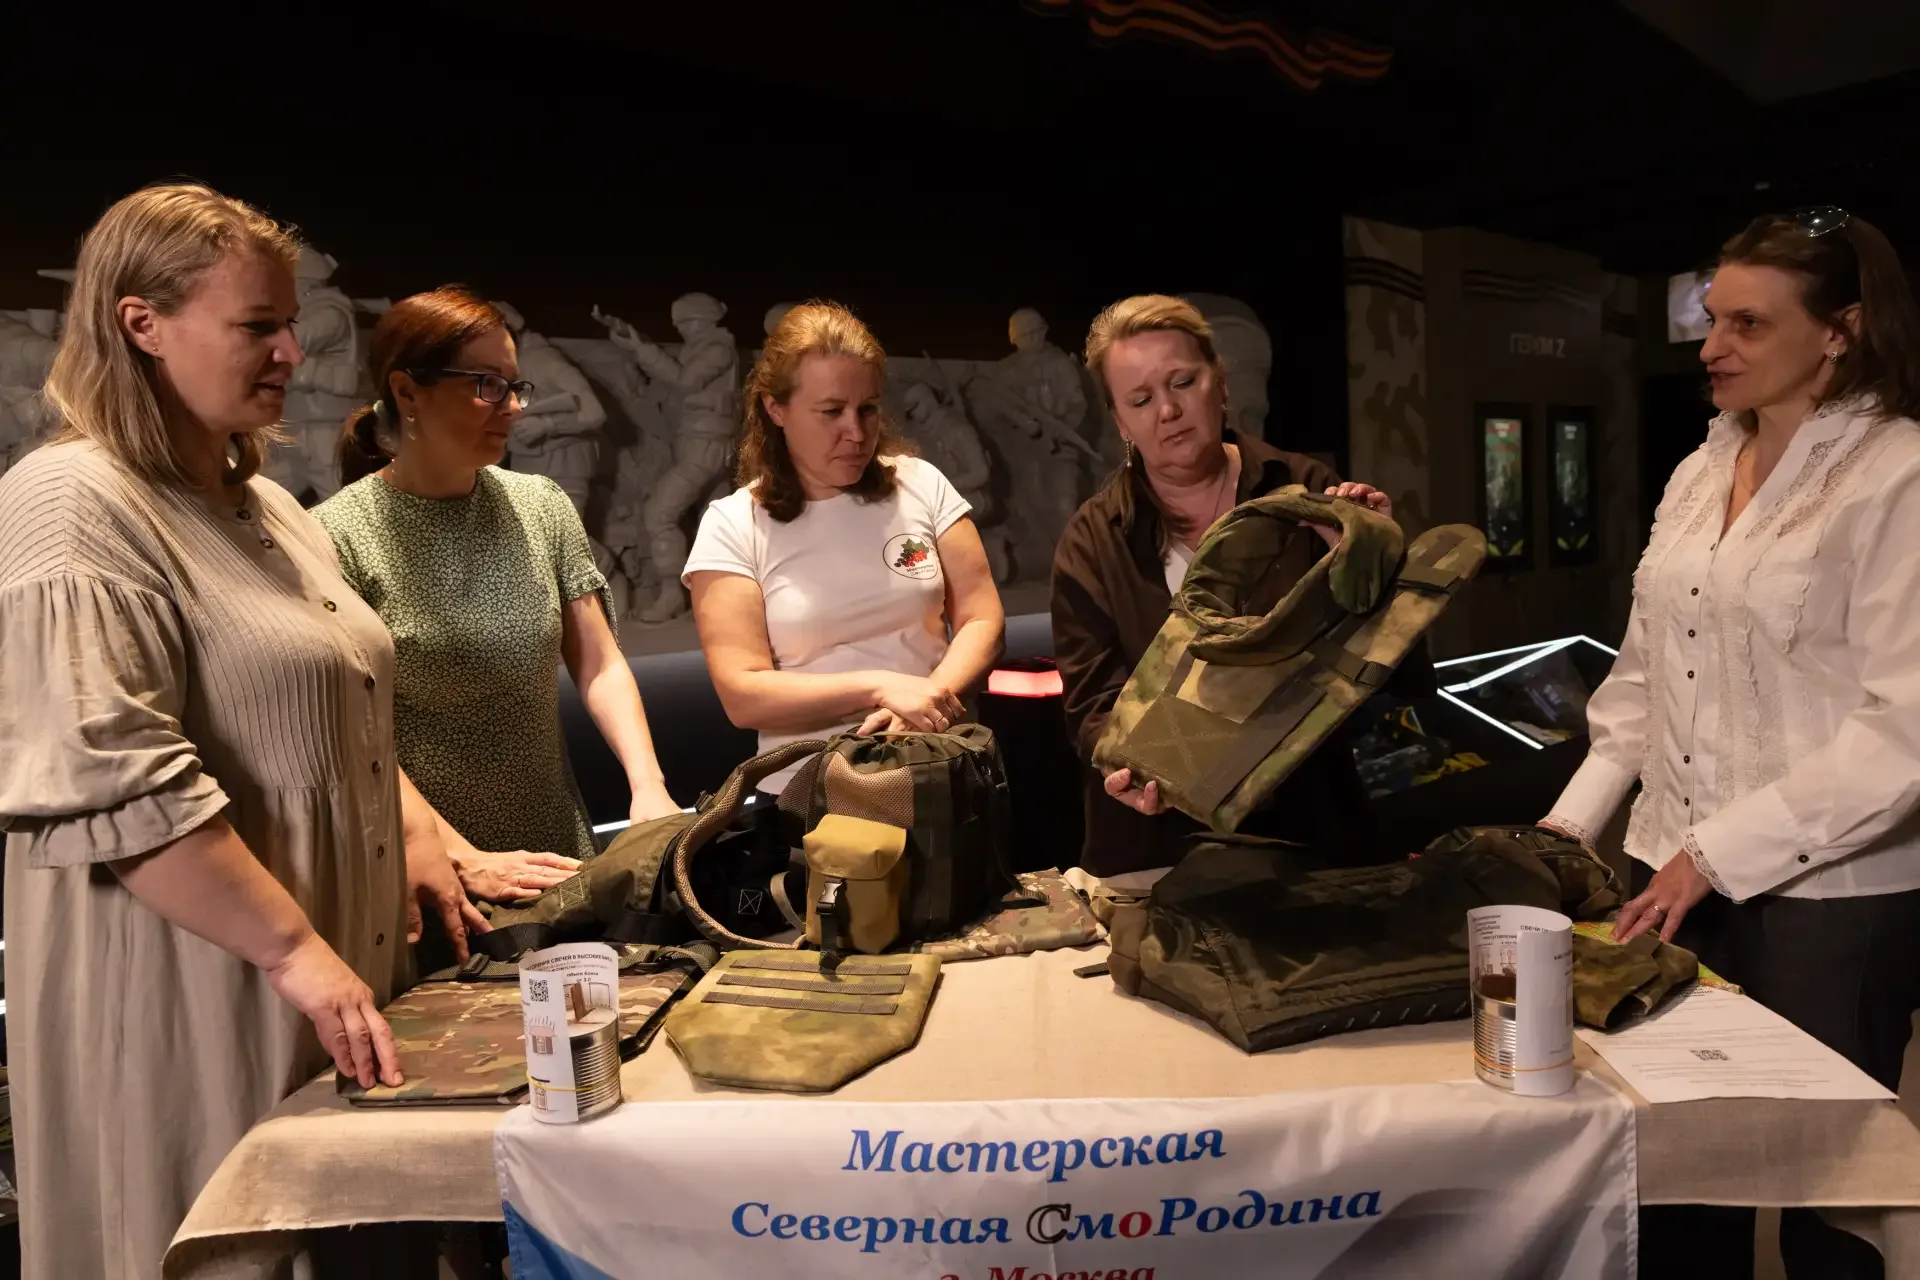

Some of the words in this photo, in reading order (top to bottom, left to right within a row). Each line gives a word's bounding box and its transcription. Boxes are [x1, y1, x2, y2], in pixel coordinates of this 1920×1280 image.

[550, 954, 572, 964] СВЕЧЕЙ
[841, 1128, 1227, 1183] Мастерская
[731, 1202, 1013, 1253] Северная
[1026, 1189, 1383, 1245] СмоРодина
